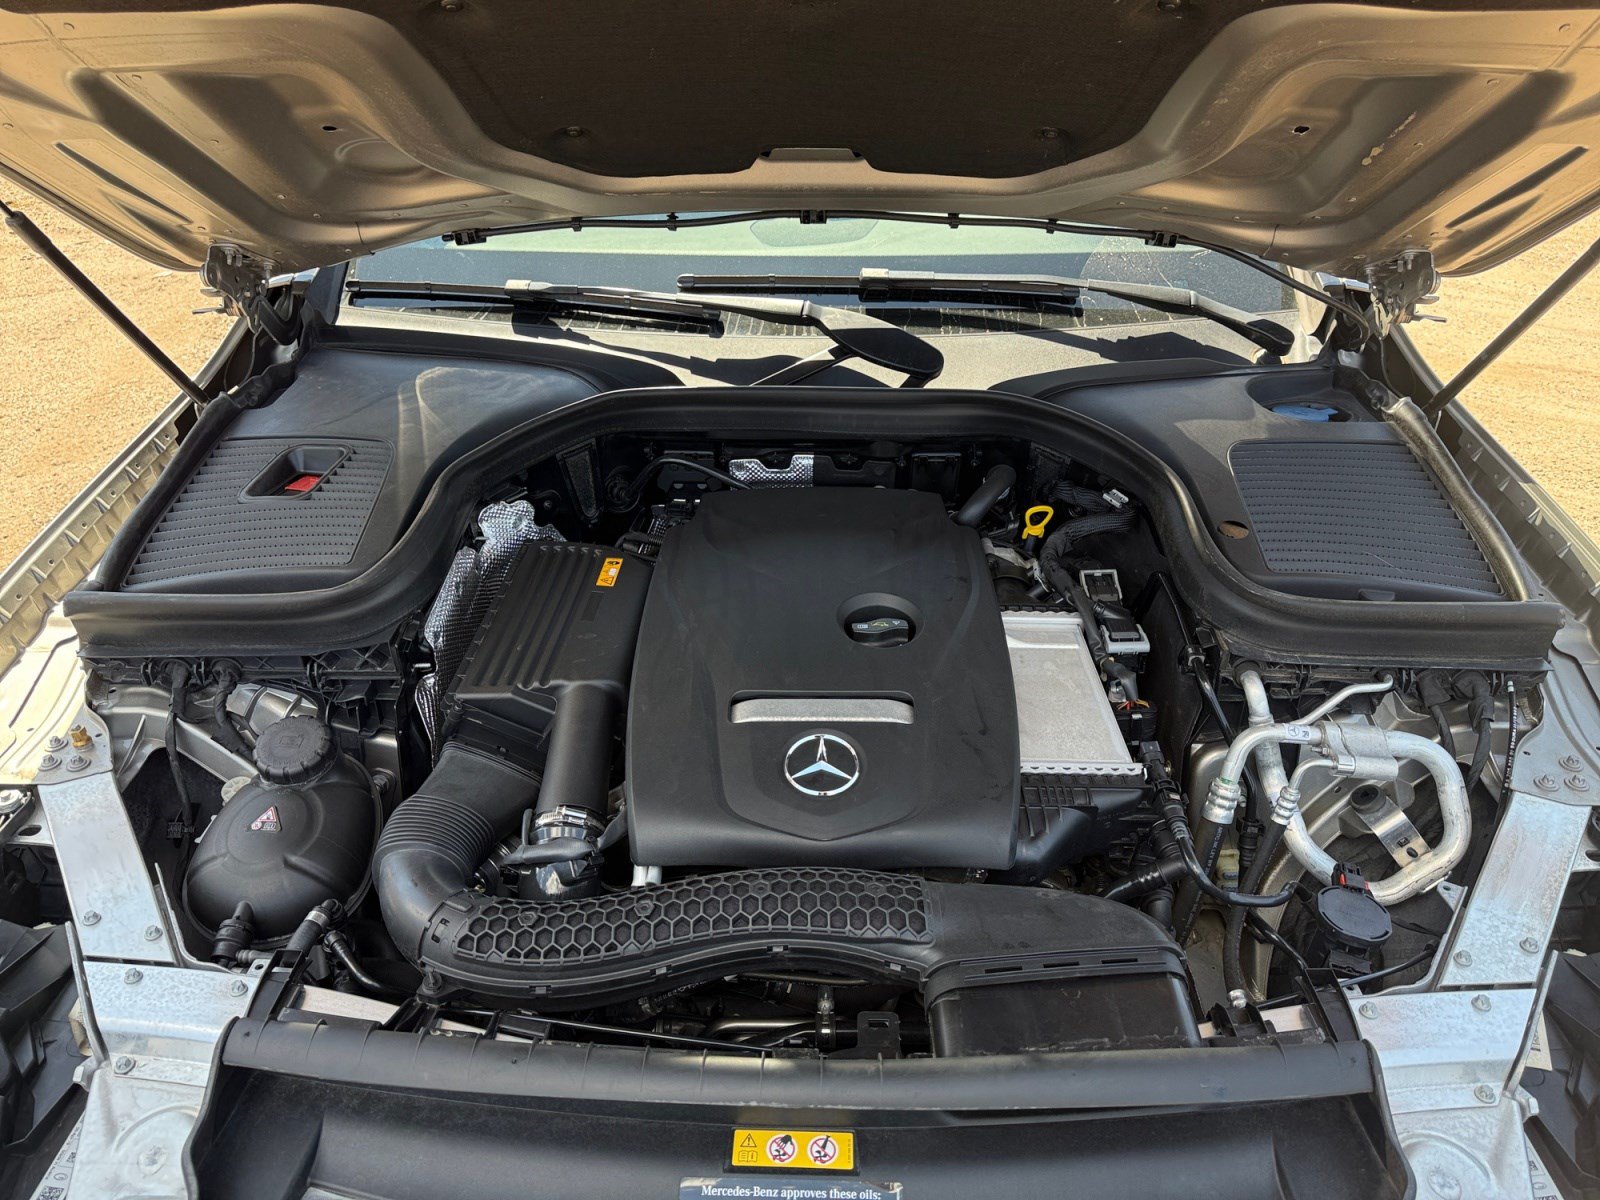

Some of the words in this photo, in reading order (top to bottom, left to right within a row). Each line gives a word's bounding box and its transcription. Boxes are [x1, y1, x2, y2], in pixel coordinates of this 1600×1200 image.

[701, 1186, 778, 1198] Mercedes-Benz
[781, 1187, 826, 1200] approves
[829, 1188, 857, 1199] these
[859, 1187, 881, 1200] oils:
